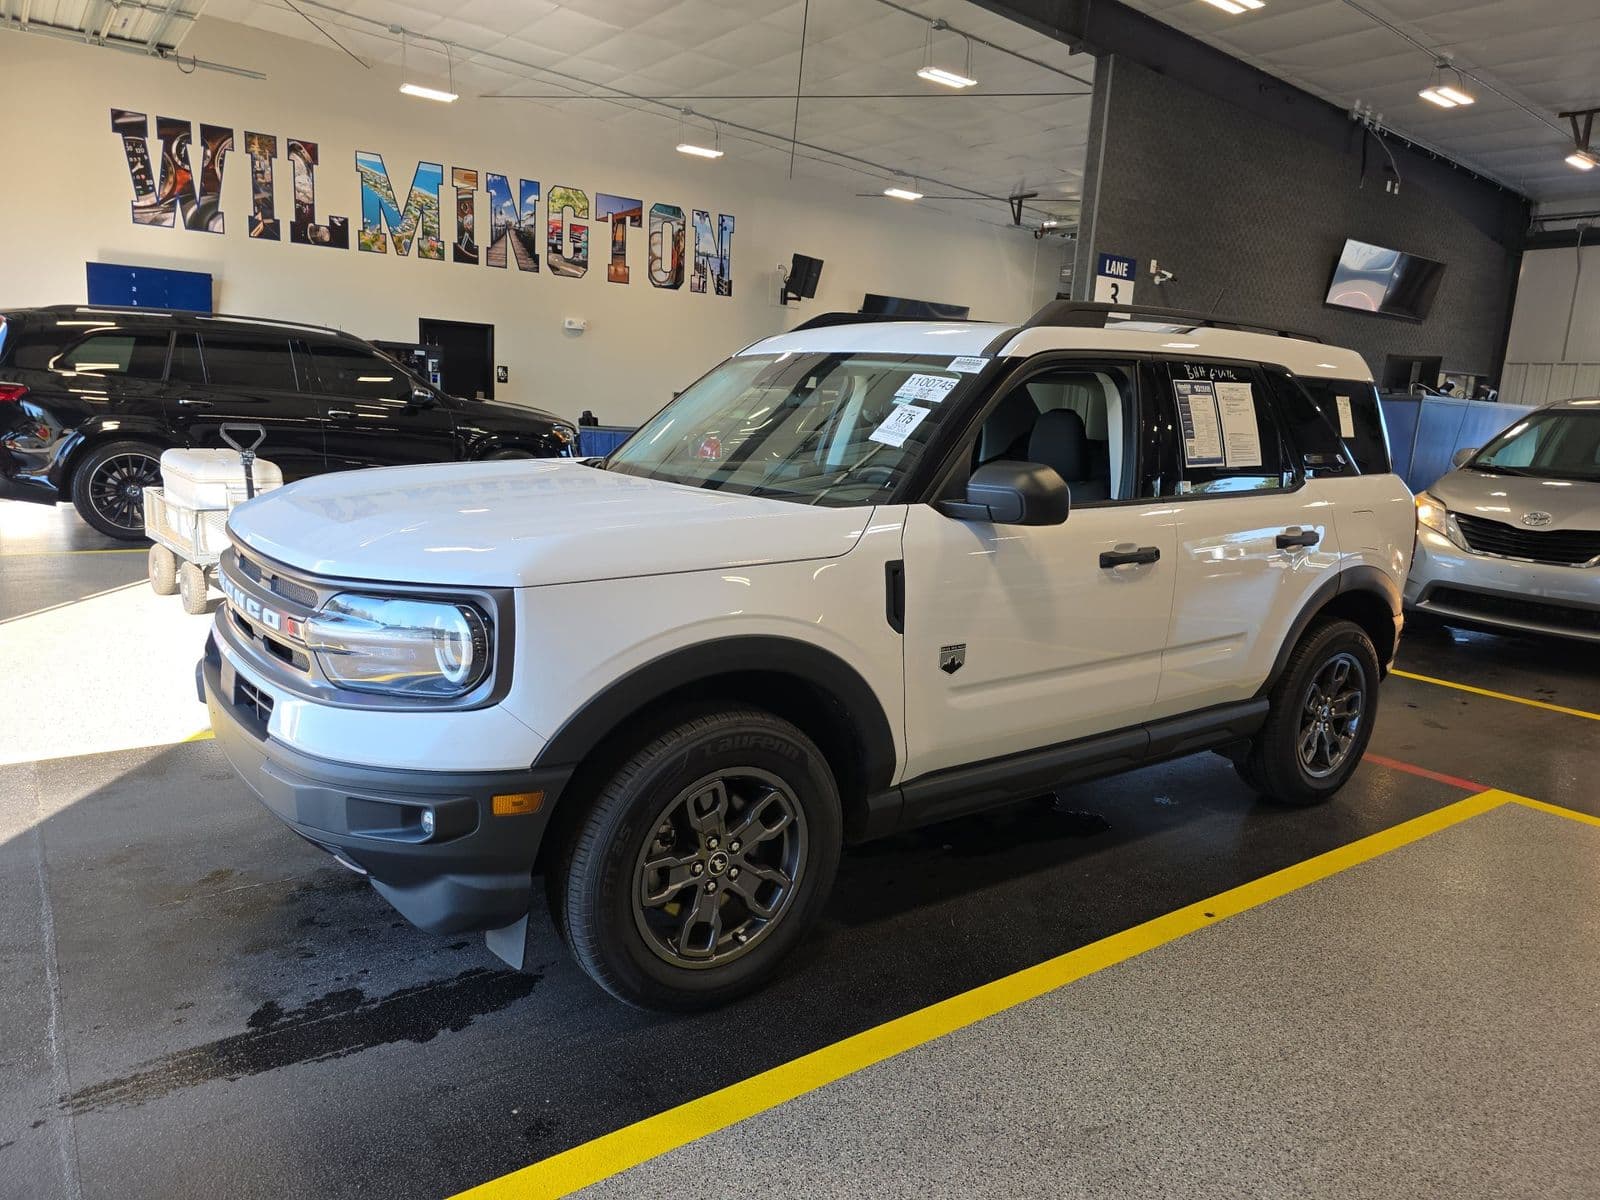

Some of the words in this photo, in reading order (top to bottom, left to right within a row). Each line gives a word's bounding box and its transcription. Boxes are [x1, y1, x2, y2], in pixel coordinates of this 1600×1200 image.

[110, 107, 735, 297] WILMINGTON
[1105, 259, 1129, 277] LANE
[1111, 282, 1119, 304] 3
[908, 376, 956, 391] 1100745
[217, 566, 280, 630] ONCO
